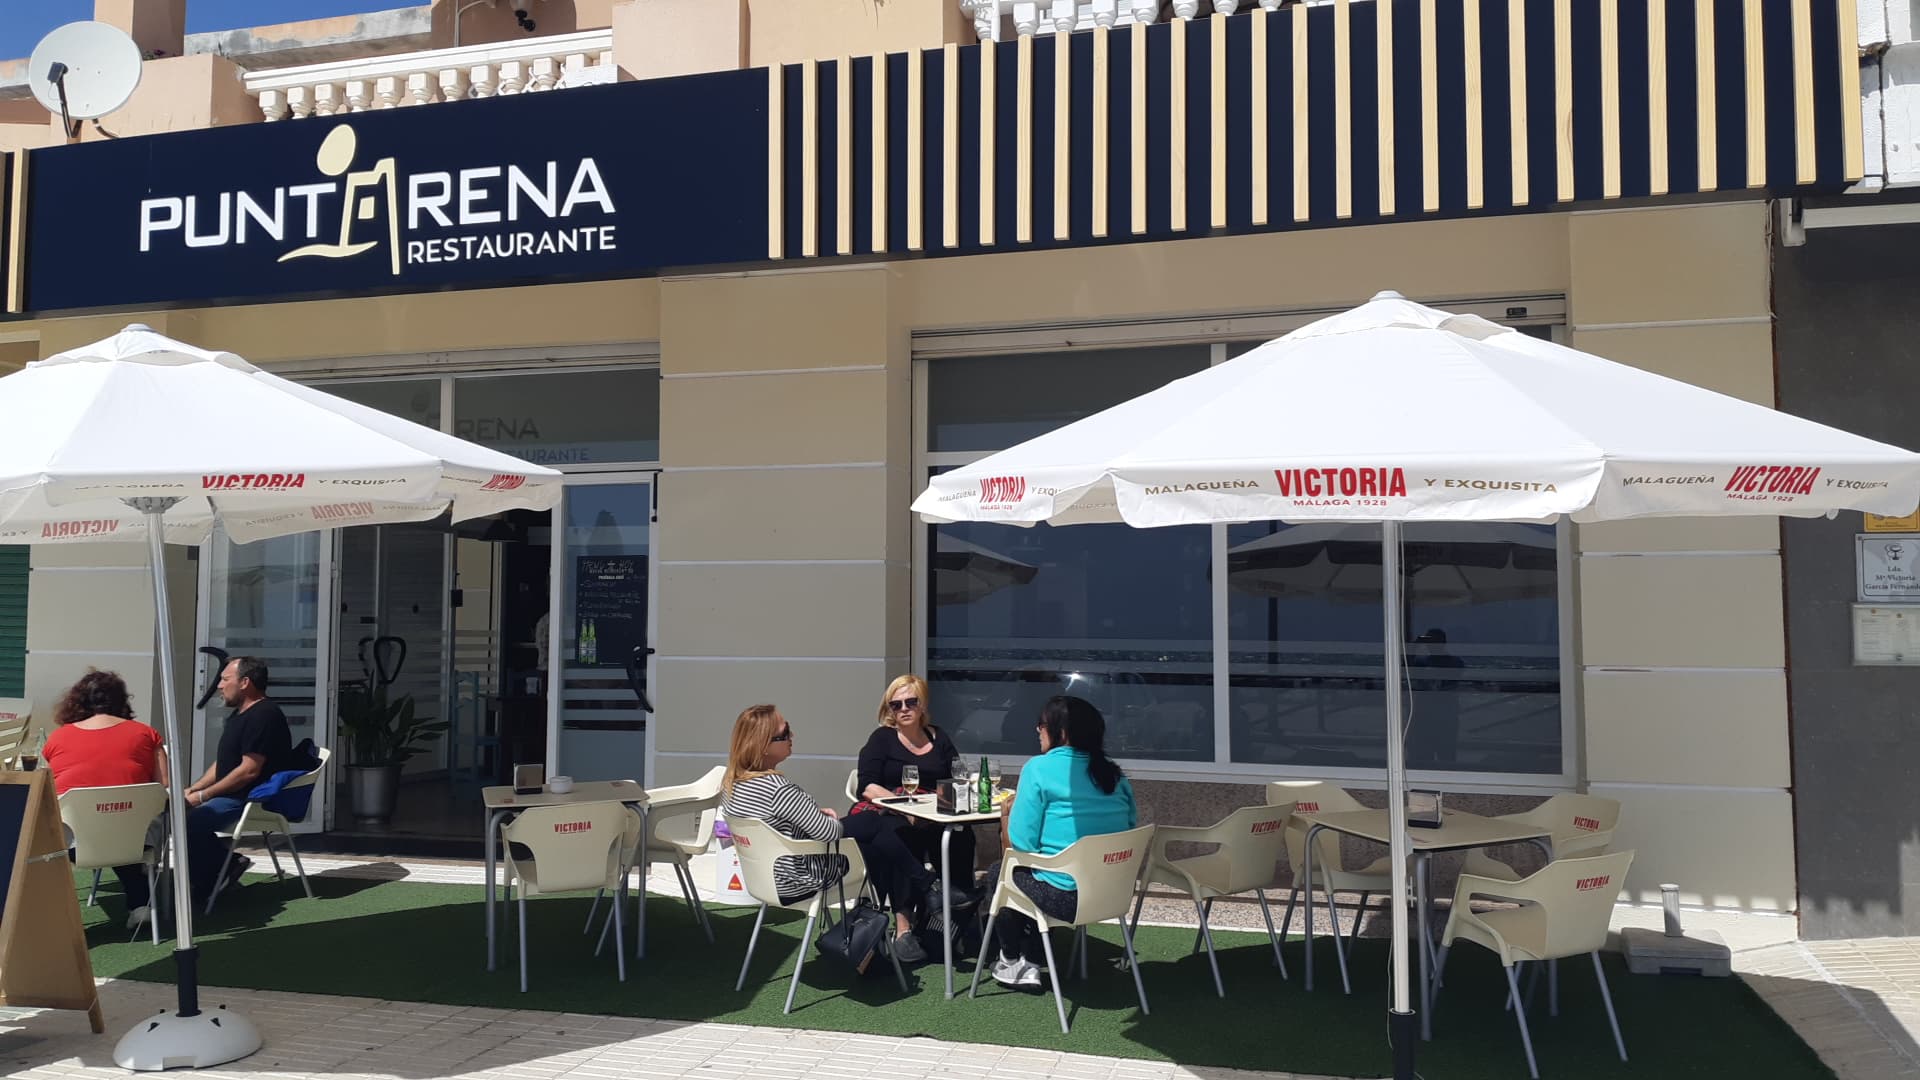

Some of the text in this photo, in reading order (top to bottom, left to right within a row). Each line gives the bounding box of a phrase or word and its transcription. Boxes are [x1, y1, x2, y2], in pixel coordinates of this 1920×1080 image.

[407, 225, 617, 264] RESTAURANTE
[202, 473, 305, 489] VICTORIA
[333, 477, 407, 486] EXQUISITA
[1145, 467, 1559, 497] MALAGUEÑA VICTORIA Y EXQUISITA
[1623, 474, 1715, 487] MALAGUEÑA
[1724, 465, 1821, 495] VICTORIA
[1826, 478, 1835, 488] Y
[979, 476, 1026, 504] VICTORIA
[1772, 495, 1794, 503] 1928
[96, 801, 133, 812] VICTORIA
[554, 821, 592, 833] VICTORIA
[1251, 818, 1282, 833] VICTORIA
[1573, 816, 1600, 830] VICTORIA
[1103, 848, 1133, 863] VICTORIA
[1576, 875, 1610, 889] VICTORIA
